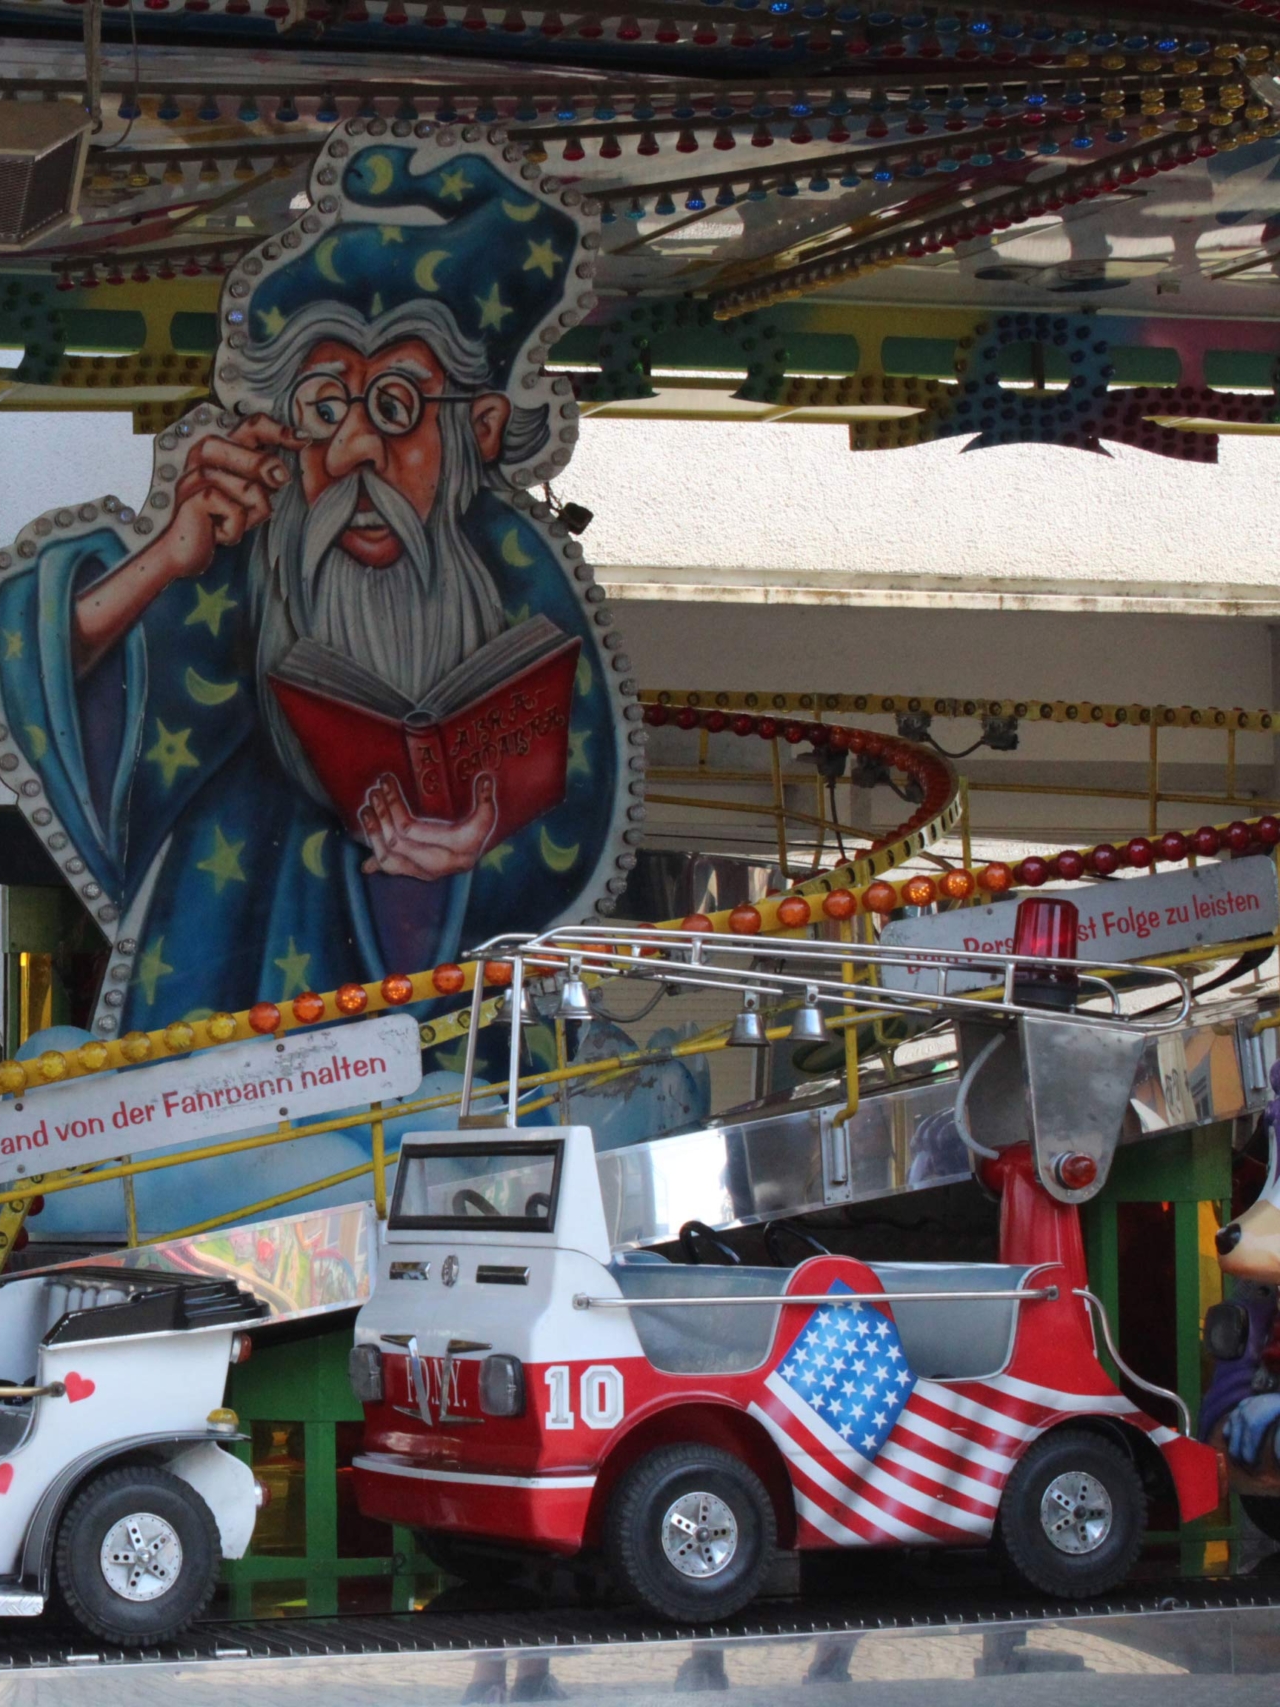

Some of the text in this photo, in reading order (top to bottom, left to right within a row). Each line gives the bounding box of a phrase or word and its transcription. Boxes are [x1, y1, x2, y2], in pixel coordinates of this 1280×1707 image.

[1077, 916, 1097, 941] st
[1102, 906, 1160, 939] Folge
[1164, 904, 1189, 926] zu
[1192, 891, 1260, 920] leisten
[55, 1116, 105, 1142] von
[112, 1101, 156, 1130] der
[544, 1364, 624, 1430] 10
